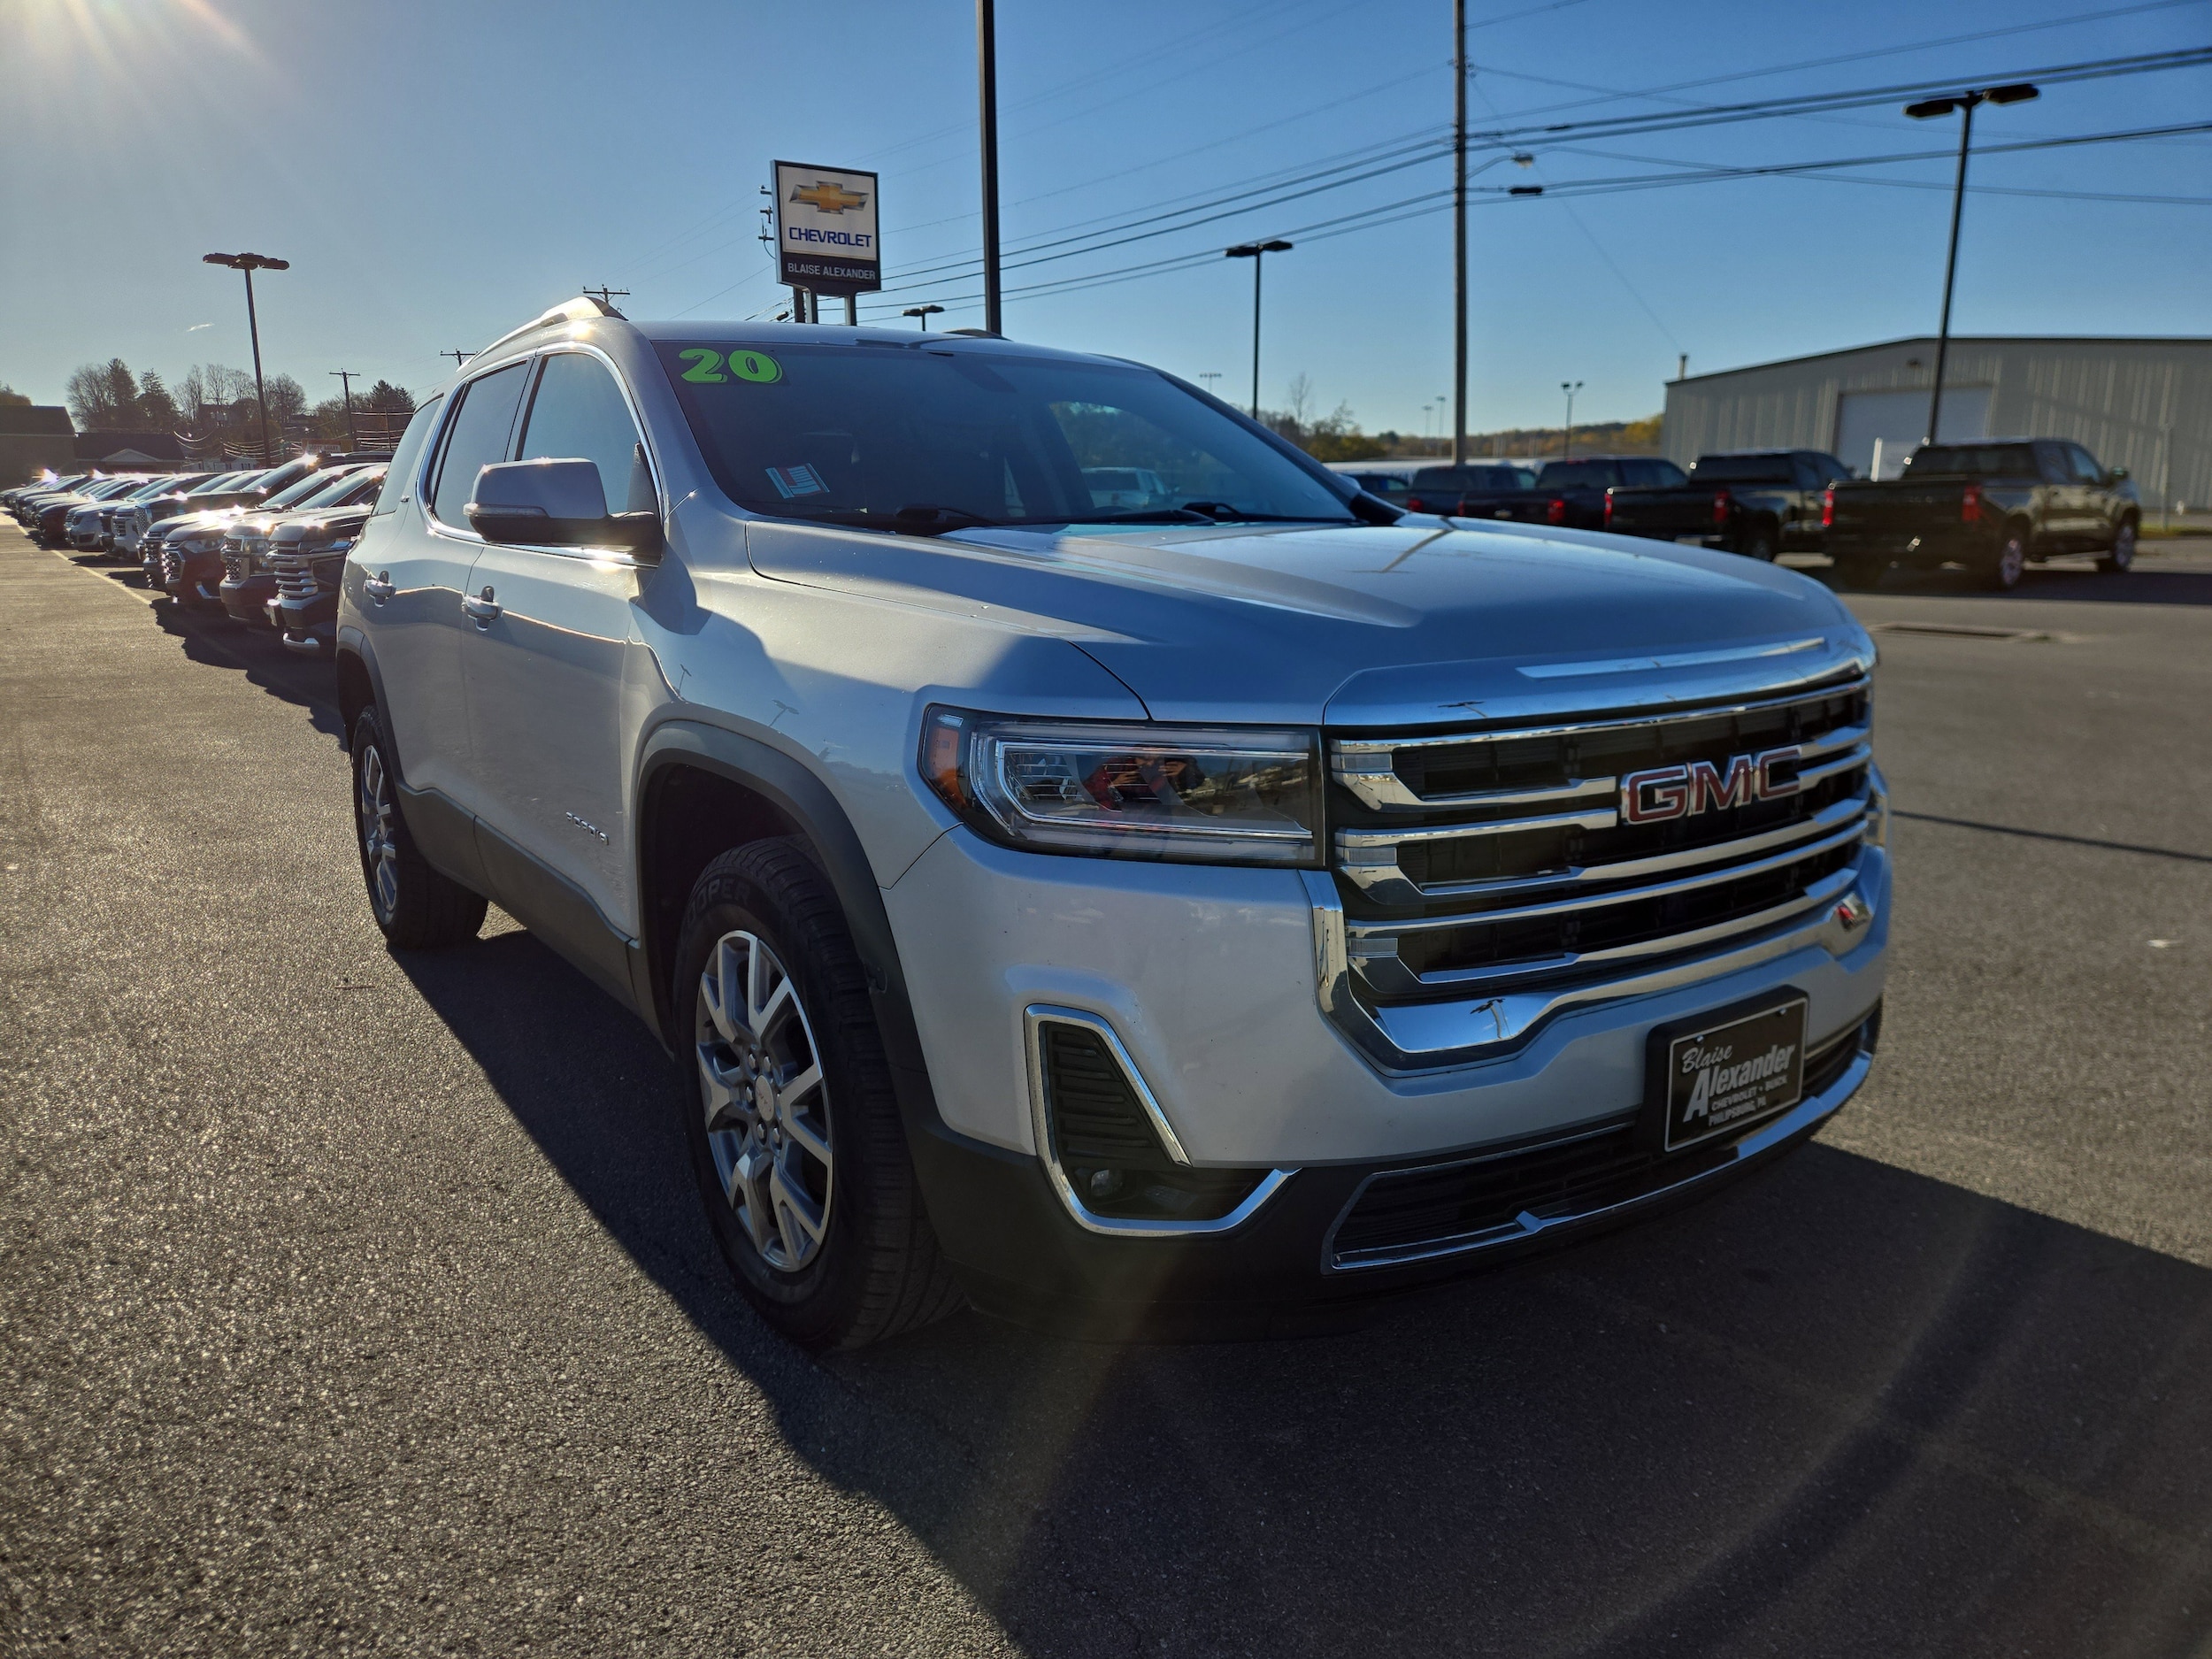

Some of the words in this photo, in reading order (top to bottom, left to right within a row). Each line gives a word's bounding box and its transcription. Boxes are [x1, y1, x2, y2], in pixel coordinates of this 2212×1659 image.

[789, 227, 872, 247] CHEVROLET
[787, 263, 820, 275] BLAISE
[823, 265, 875, 280] ALEXANDER
[679, 349, 783, 383] 20
[1621, 744, 1802, 825] GMC
[1681, 1045, 1733, 1073] Blaise
[1683, 1044, 1796, 1123] Alexander
